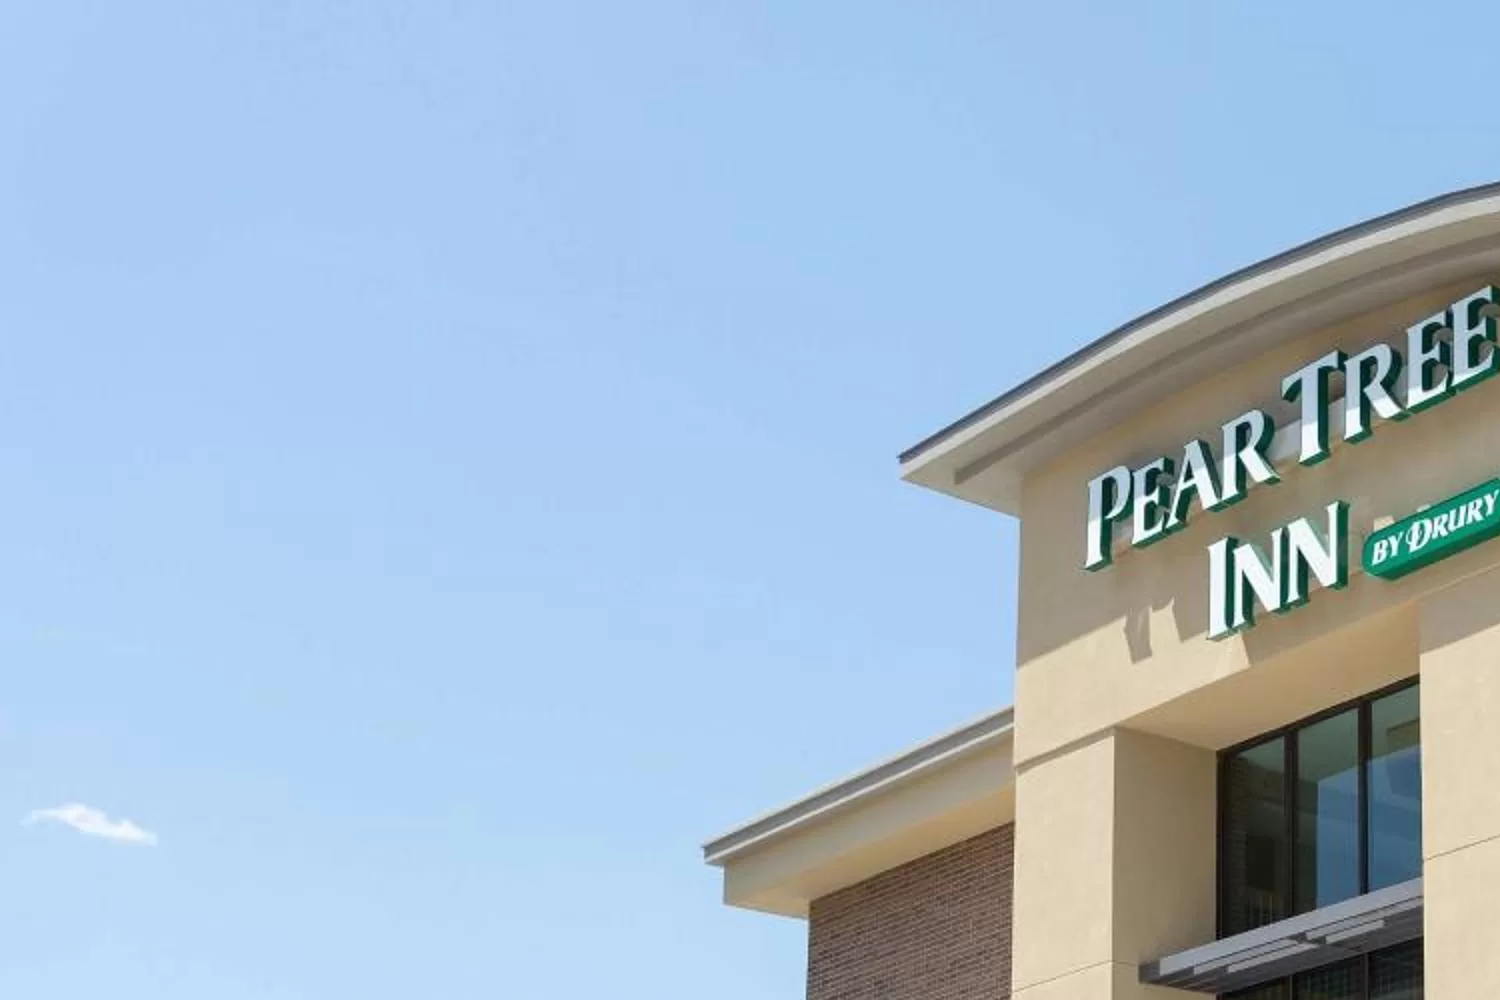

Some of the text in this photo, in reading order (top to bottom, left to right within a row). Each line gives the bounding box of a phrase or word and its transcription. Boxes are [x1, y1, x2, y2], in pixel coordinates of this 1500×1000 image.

[1085, 408, 1280, 571] PEAR
[1371, 489, 1500, 566] BY DRURY
[1206, 500, 1349, 641] INN
